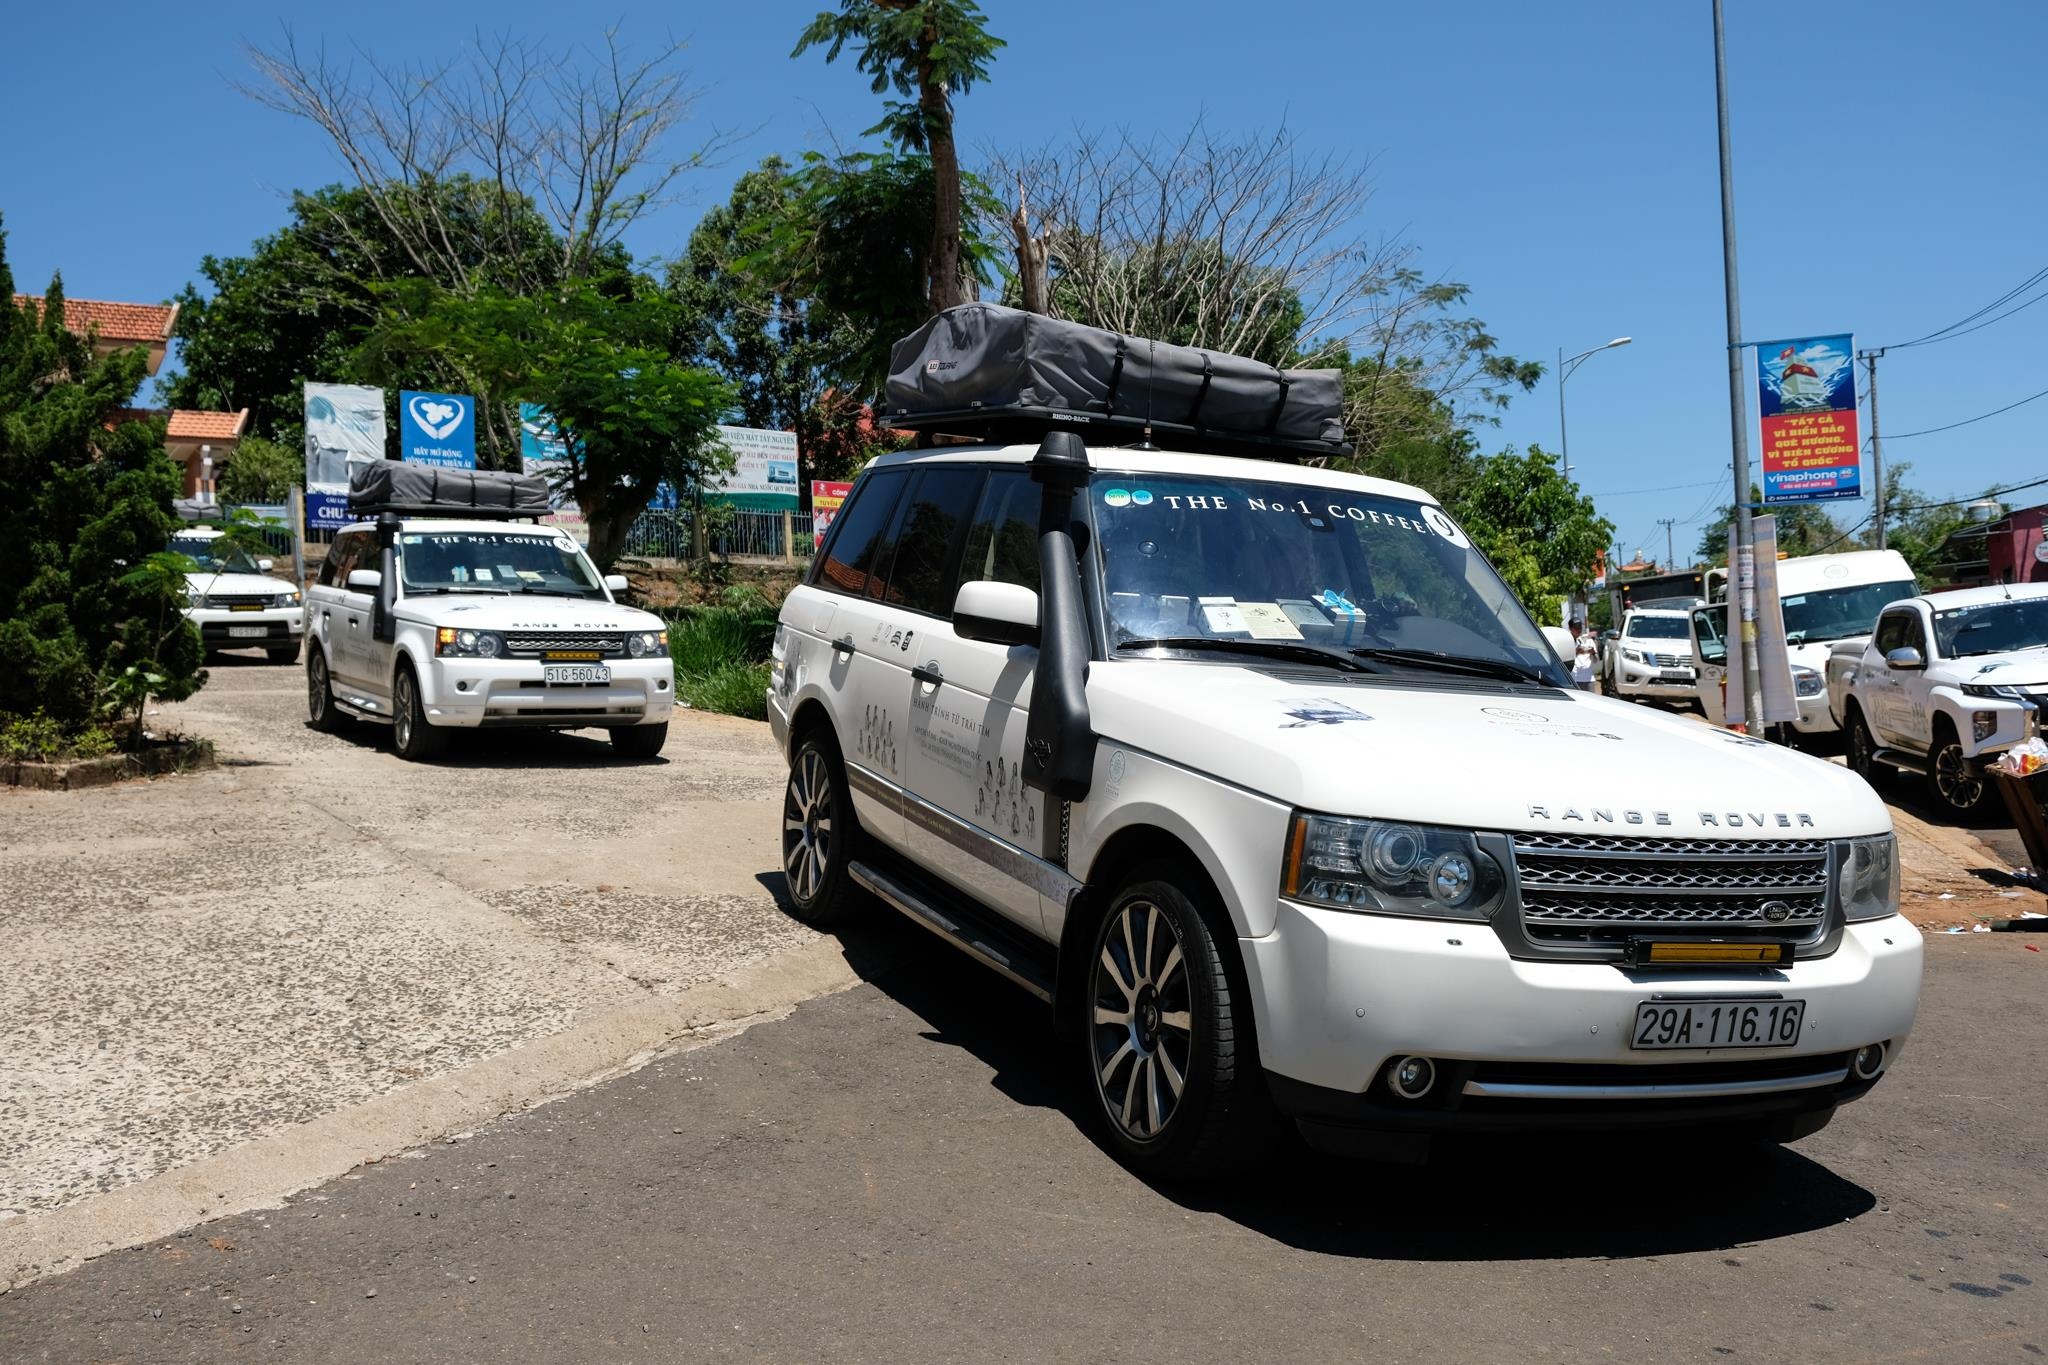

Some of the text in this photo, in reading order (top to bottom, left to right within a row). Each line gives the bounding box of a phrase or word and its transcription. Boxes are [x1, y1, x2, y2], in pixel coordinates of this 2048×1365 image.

[1052, 413, 1090, 423] RHINO-RACK
[1773, 429, 1786, 438] VÌ
[1775, 439, 1798, 448] QUÊ
[1767, 450, 1780, 459] VÌ
[1768, 471, 1838, 483] vinaphone
[1163, 496, 1228, 510] THE
[1248, 498, 1312, 514] No.1
[318, 507, 344, 519] CHU
[1433, 514, 1455, 537] 9
[431, 536, 460, 544] THE
[547, 668, 609, 682] 51G-560.43
[1527, 804, 1815, 827] RANGE ROVER
[1637, 1006, 1798, 1044] 29A-116.16
